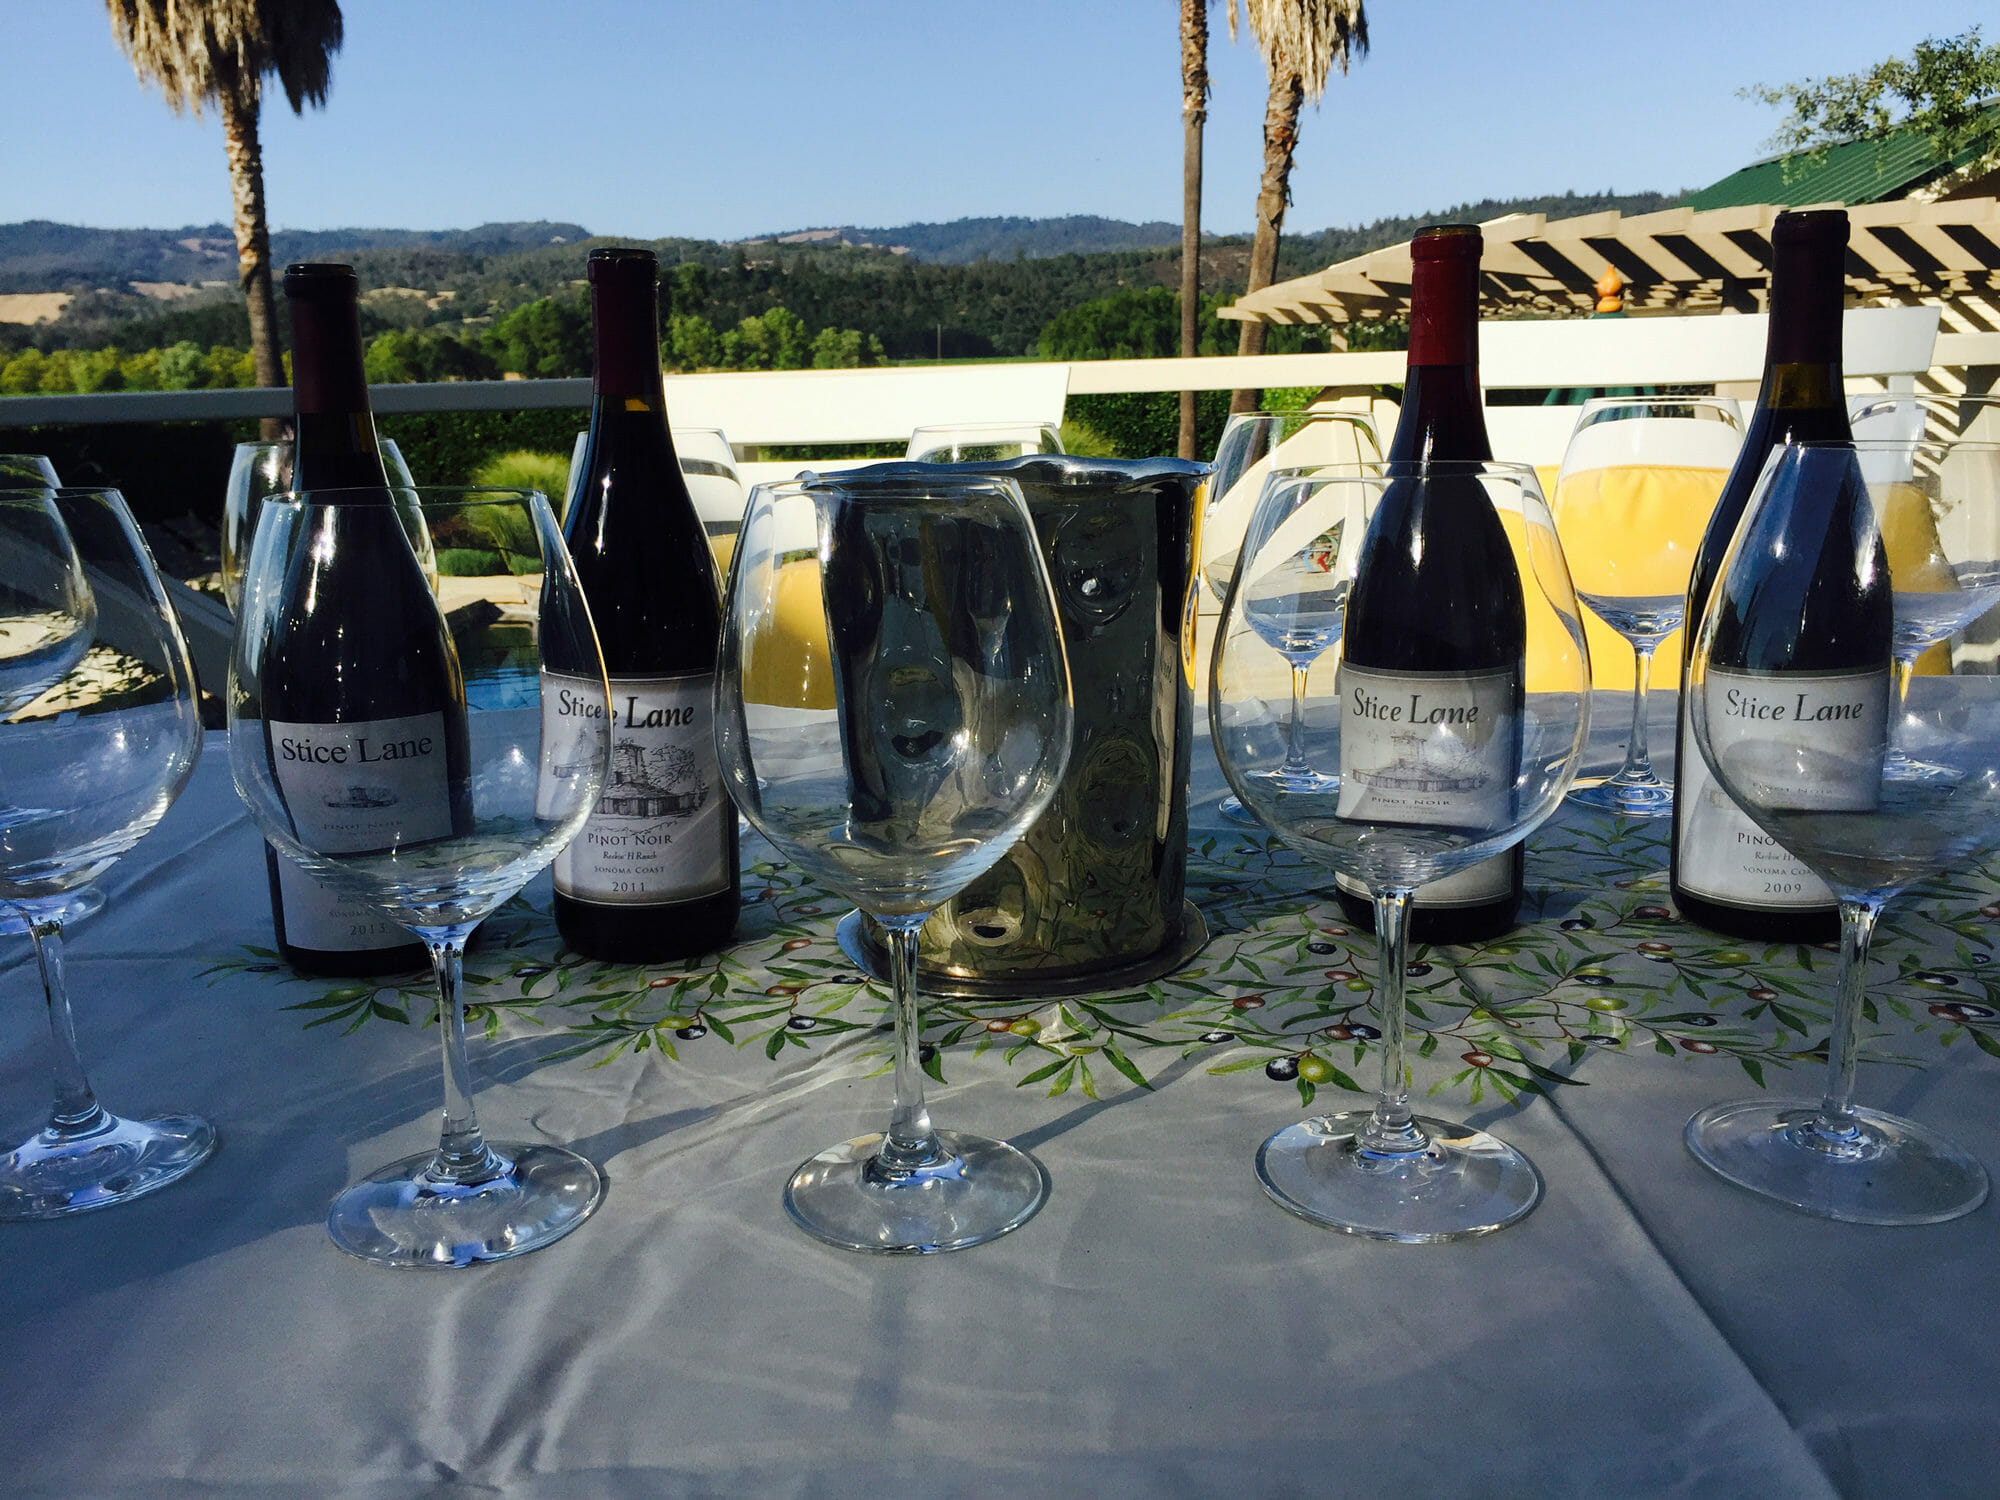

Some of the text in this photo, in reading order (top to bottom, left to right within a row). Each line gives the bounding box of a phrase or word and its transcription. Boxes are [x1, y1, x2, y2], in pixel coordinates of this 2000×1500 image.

[557, 689, 695, 729] Stice Lane
[1352, 687, 1480, 725] Stice Lane
[1725, 688, 1865, 722] Stice Lane
[281, 736, 433, 764] Stice Lane
[588, 832, 673, 847] PINOT NOIR
[1737, 832, 1776, 846] PINO
[594, 865, 665, 874] SONOMA COAST
[612, 881, 645, 893] 2011
[1763, 882, 1802, 894] 2009
